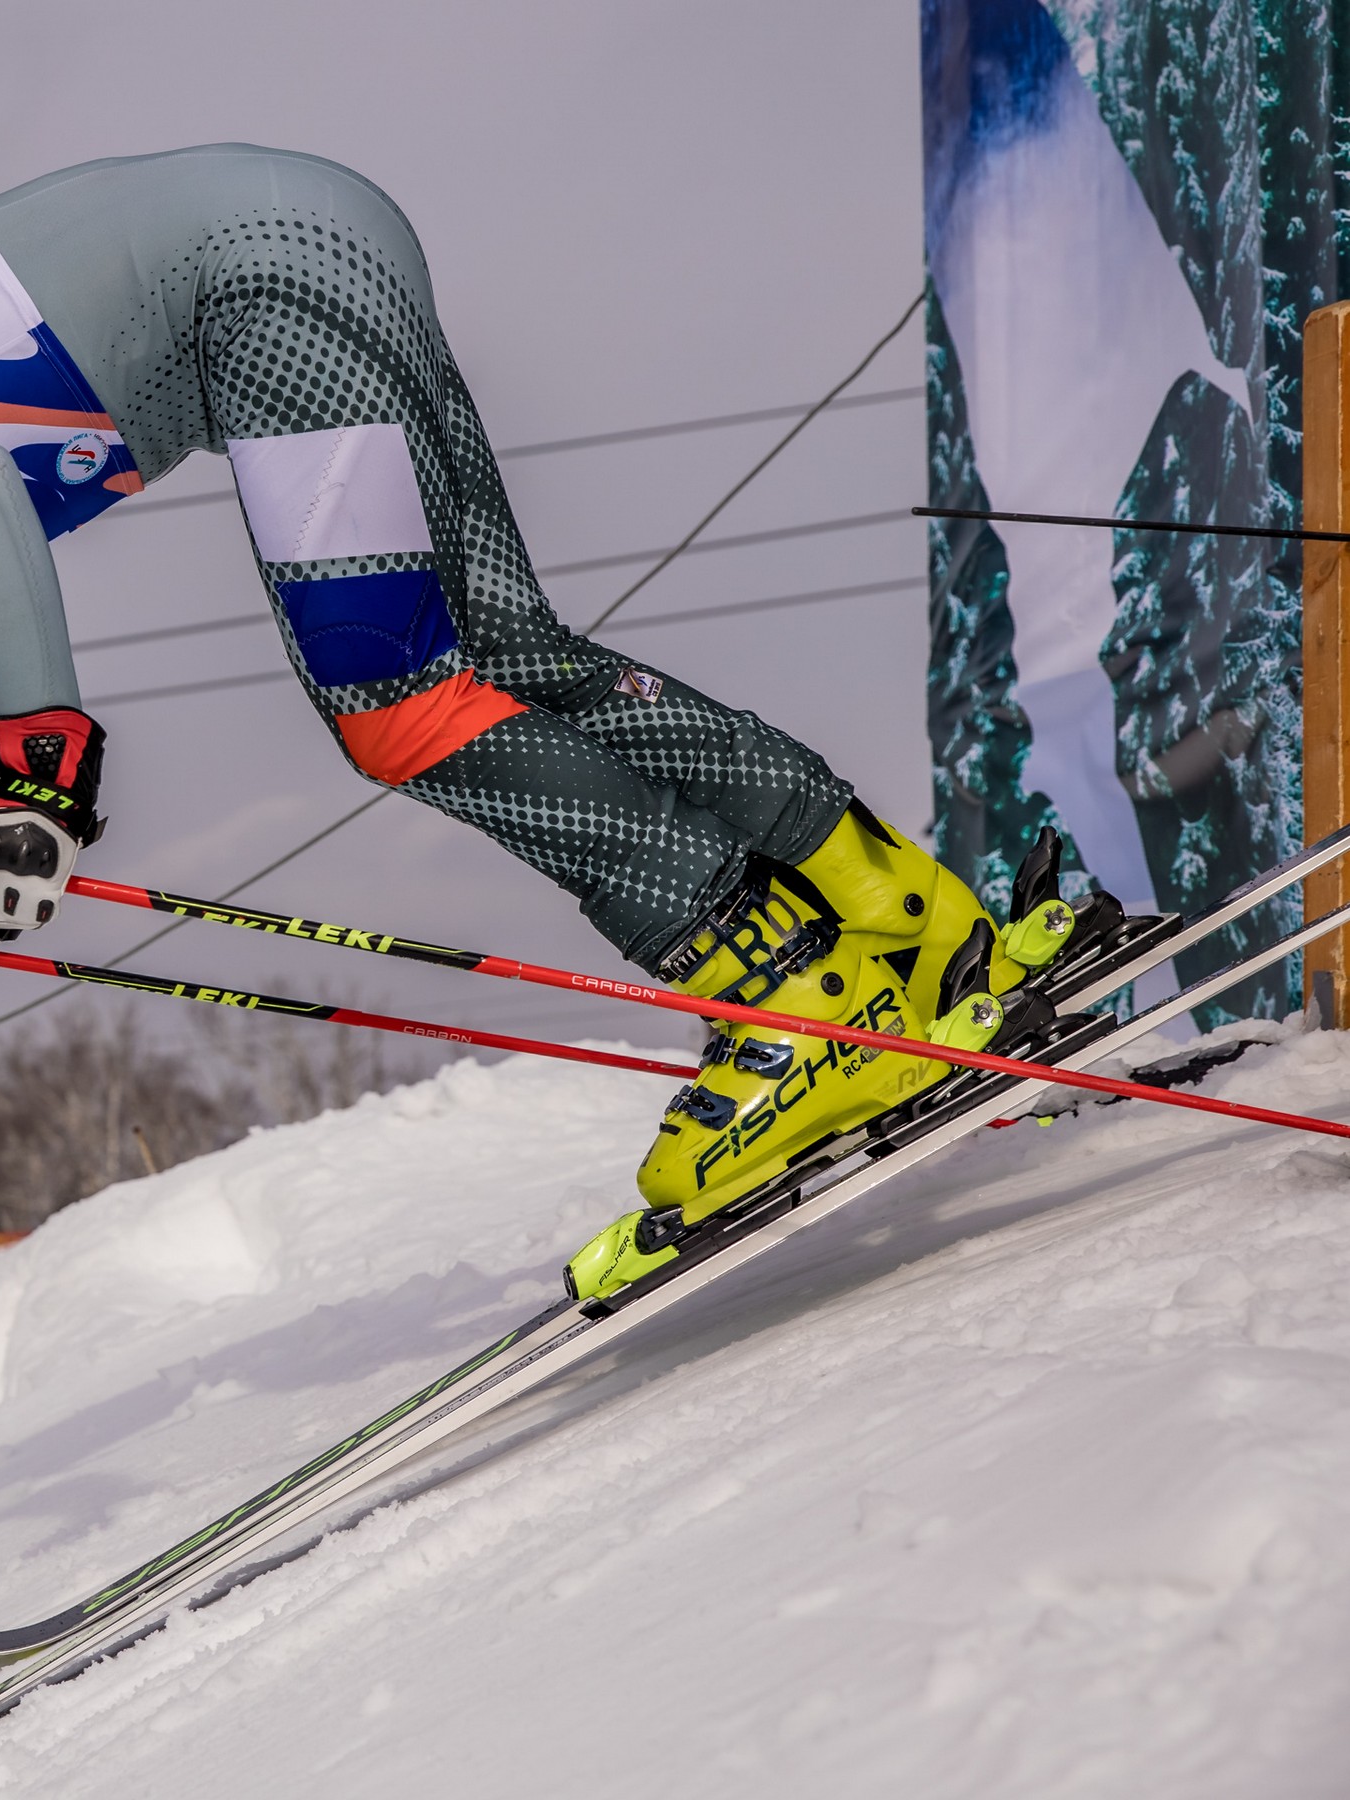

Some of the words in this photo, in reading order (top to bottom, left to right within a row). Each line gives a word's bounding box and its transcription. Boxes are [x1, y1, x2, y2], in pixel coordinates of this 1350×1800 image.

[7, 778, 74, 810] LEKI
[285, 917, 395, 953] LEKI
[171, 983, 261, 1010] LEKI
[571, 973, 657, 1000] CARBON
[403, 1024, 473, 1045] CARBON
[842, 1053, 870, 1080] RC4
